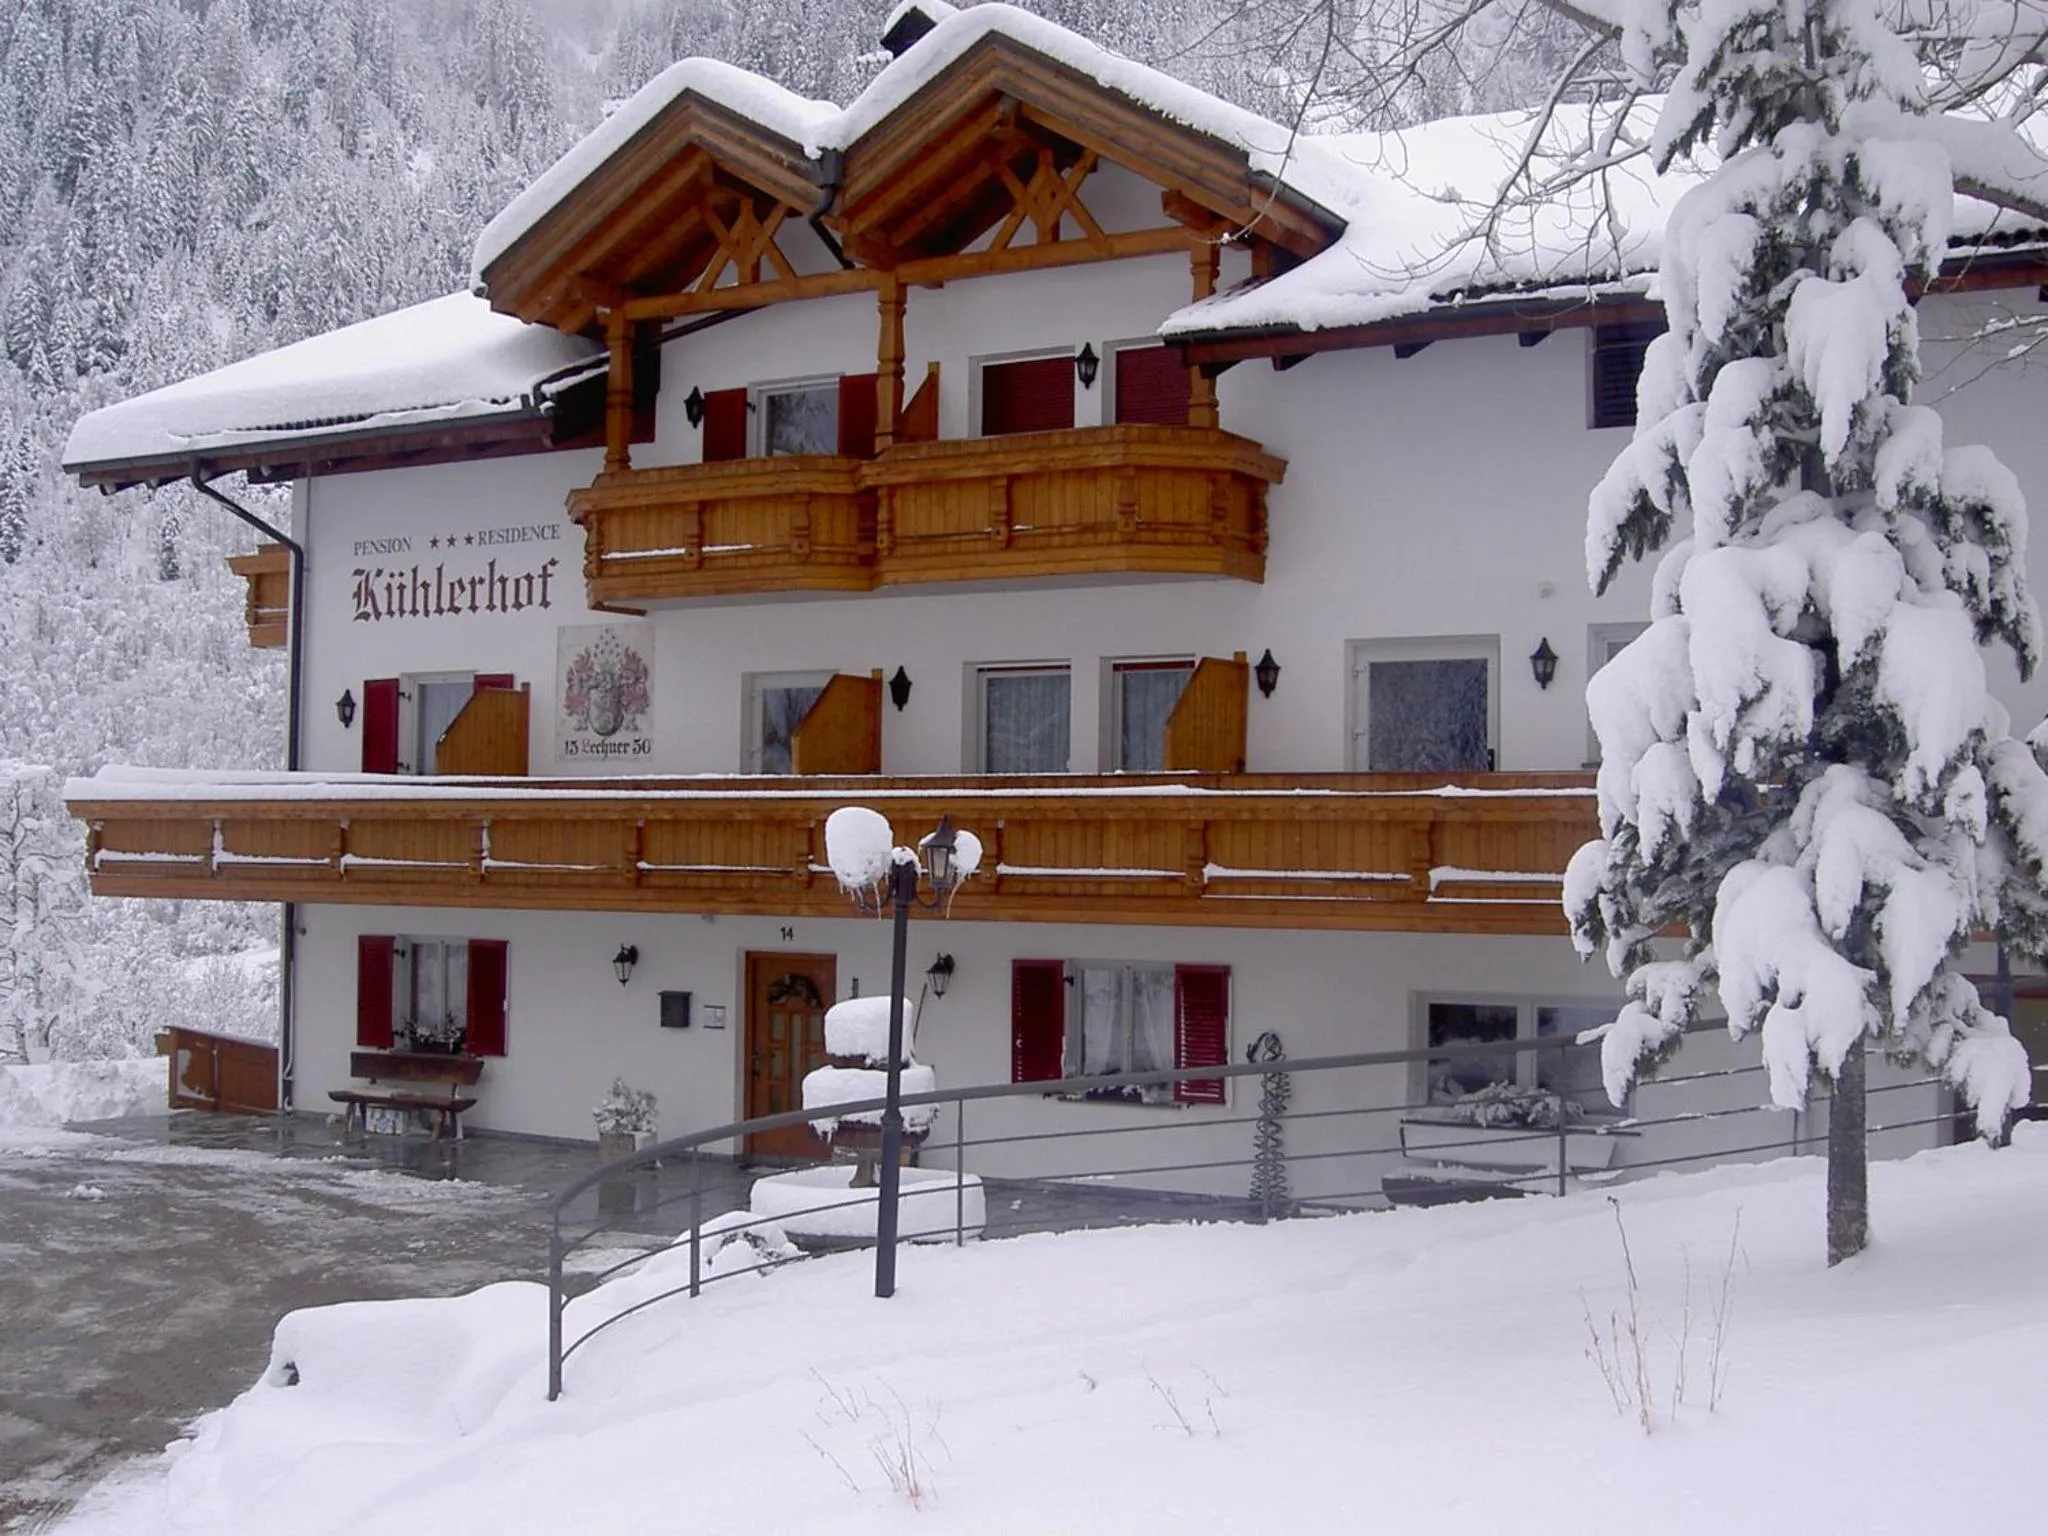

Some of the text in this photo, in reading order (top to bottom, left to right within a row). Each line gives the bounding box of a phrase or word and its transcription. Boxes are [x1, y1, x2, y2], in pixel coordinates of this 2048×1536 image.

[354, 524, 560, 556] PENSION RESIDENCE
[352, 557, 560, 622] Kühlerhof
[565, 739, 579, 755] 15
[581, 738, 630, 760] Lechner
[780, 926, 794, 941] 14
